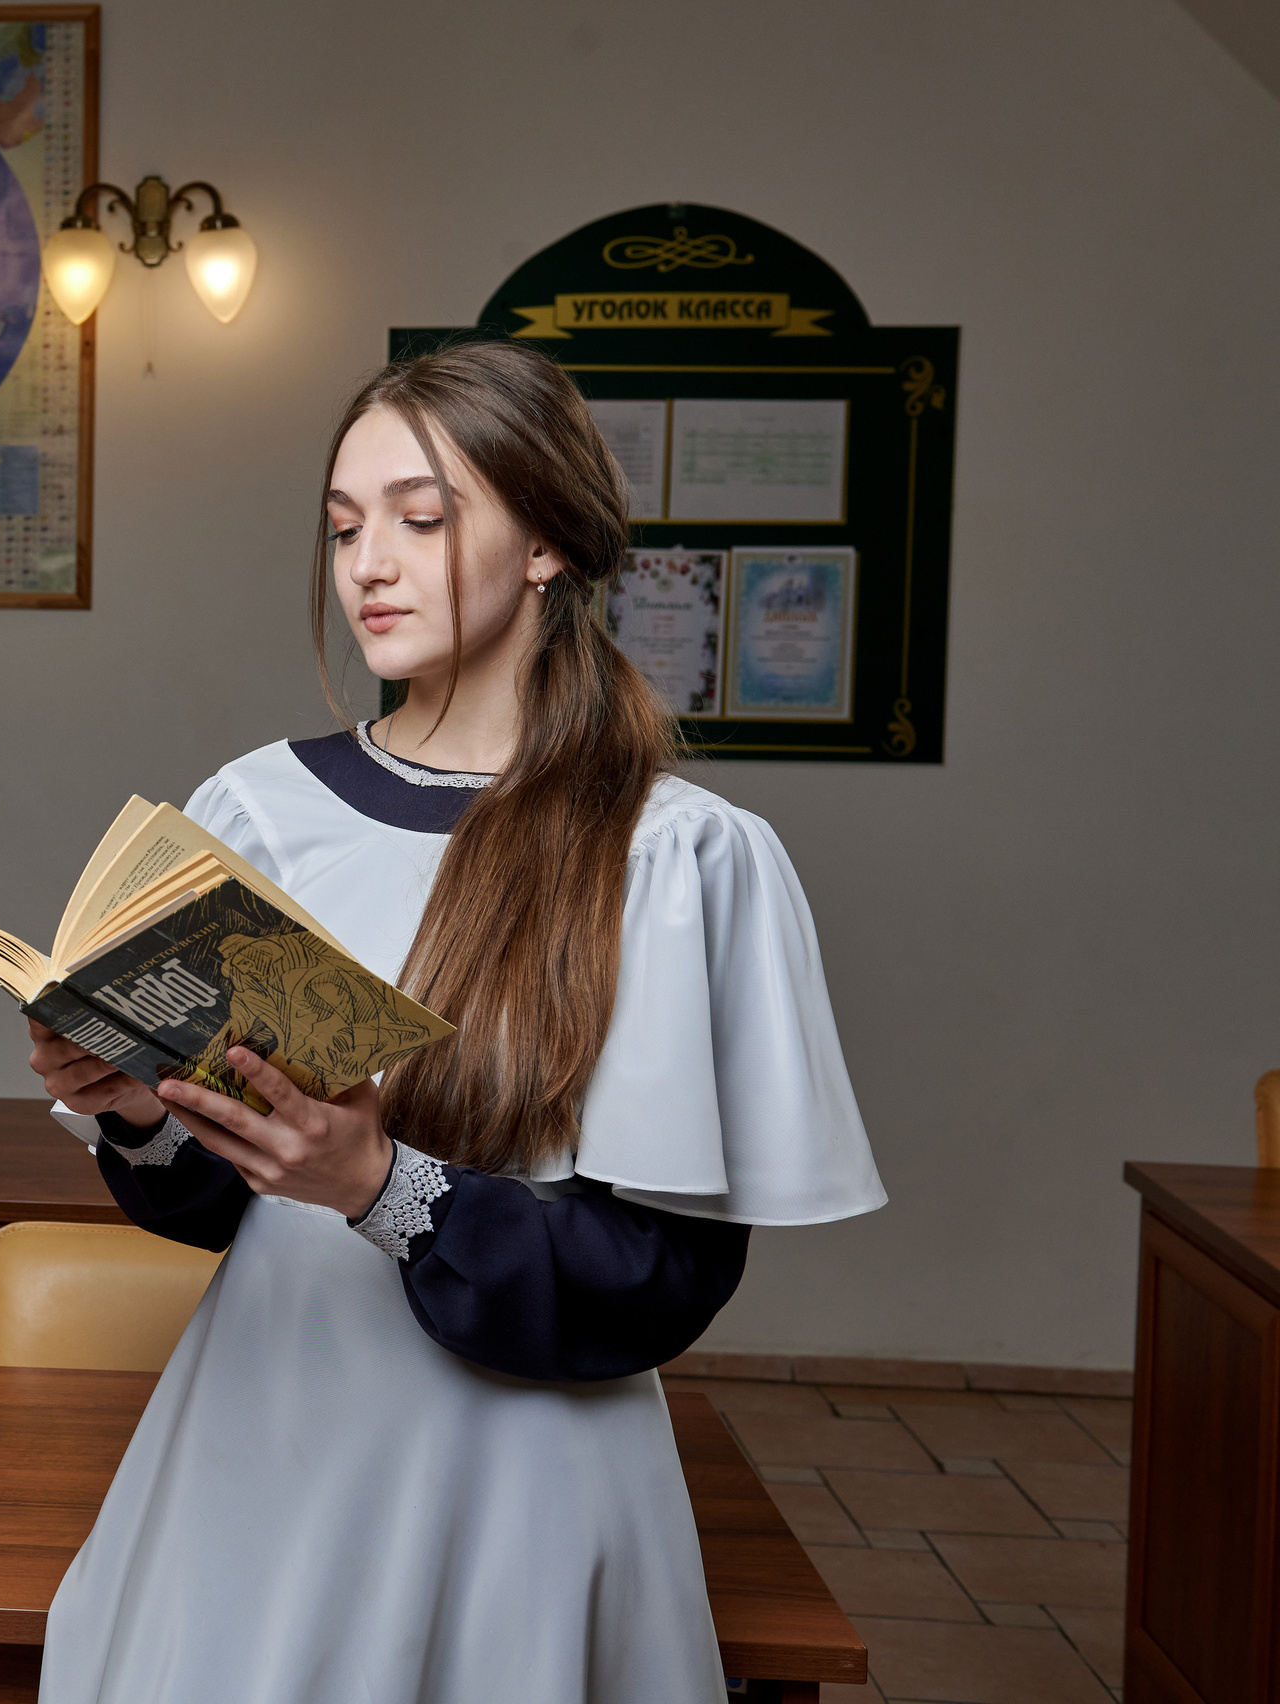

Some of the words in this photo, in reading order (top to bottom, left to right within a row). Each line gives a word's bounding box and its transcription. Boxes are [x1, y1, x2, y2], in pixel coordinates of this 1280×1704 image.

[573, 300, 669, 321] УГОЛОК
[678, 301, 772, 320] КЛАССА
[91, 957, 221, 1033] ИДИОТ
[62, 1016, 138, 1062] ИДИОТ
